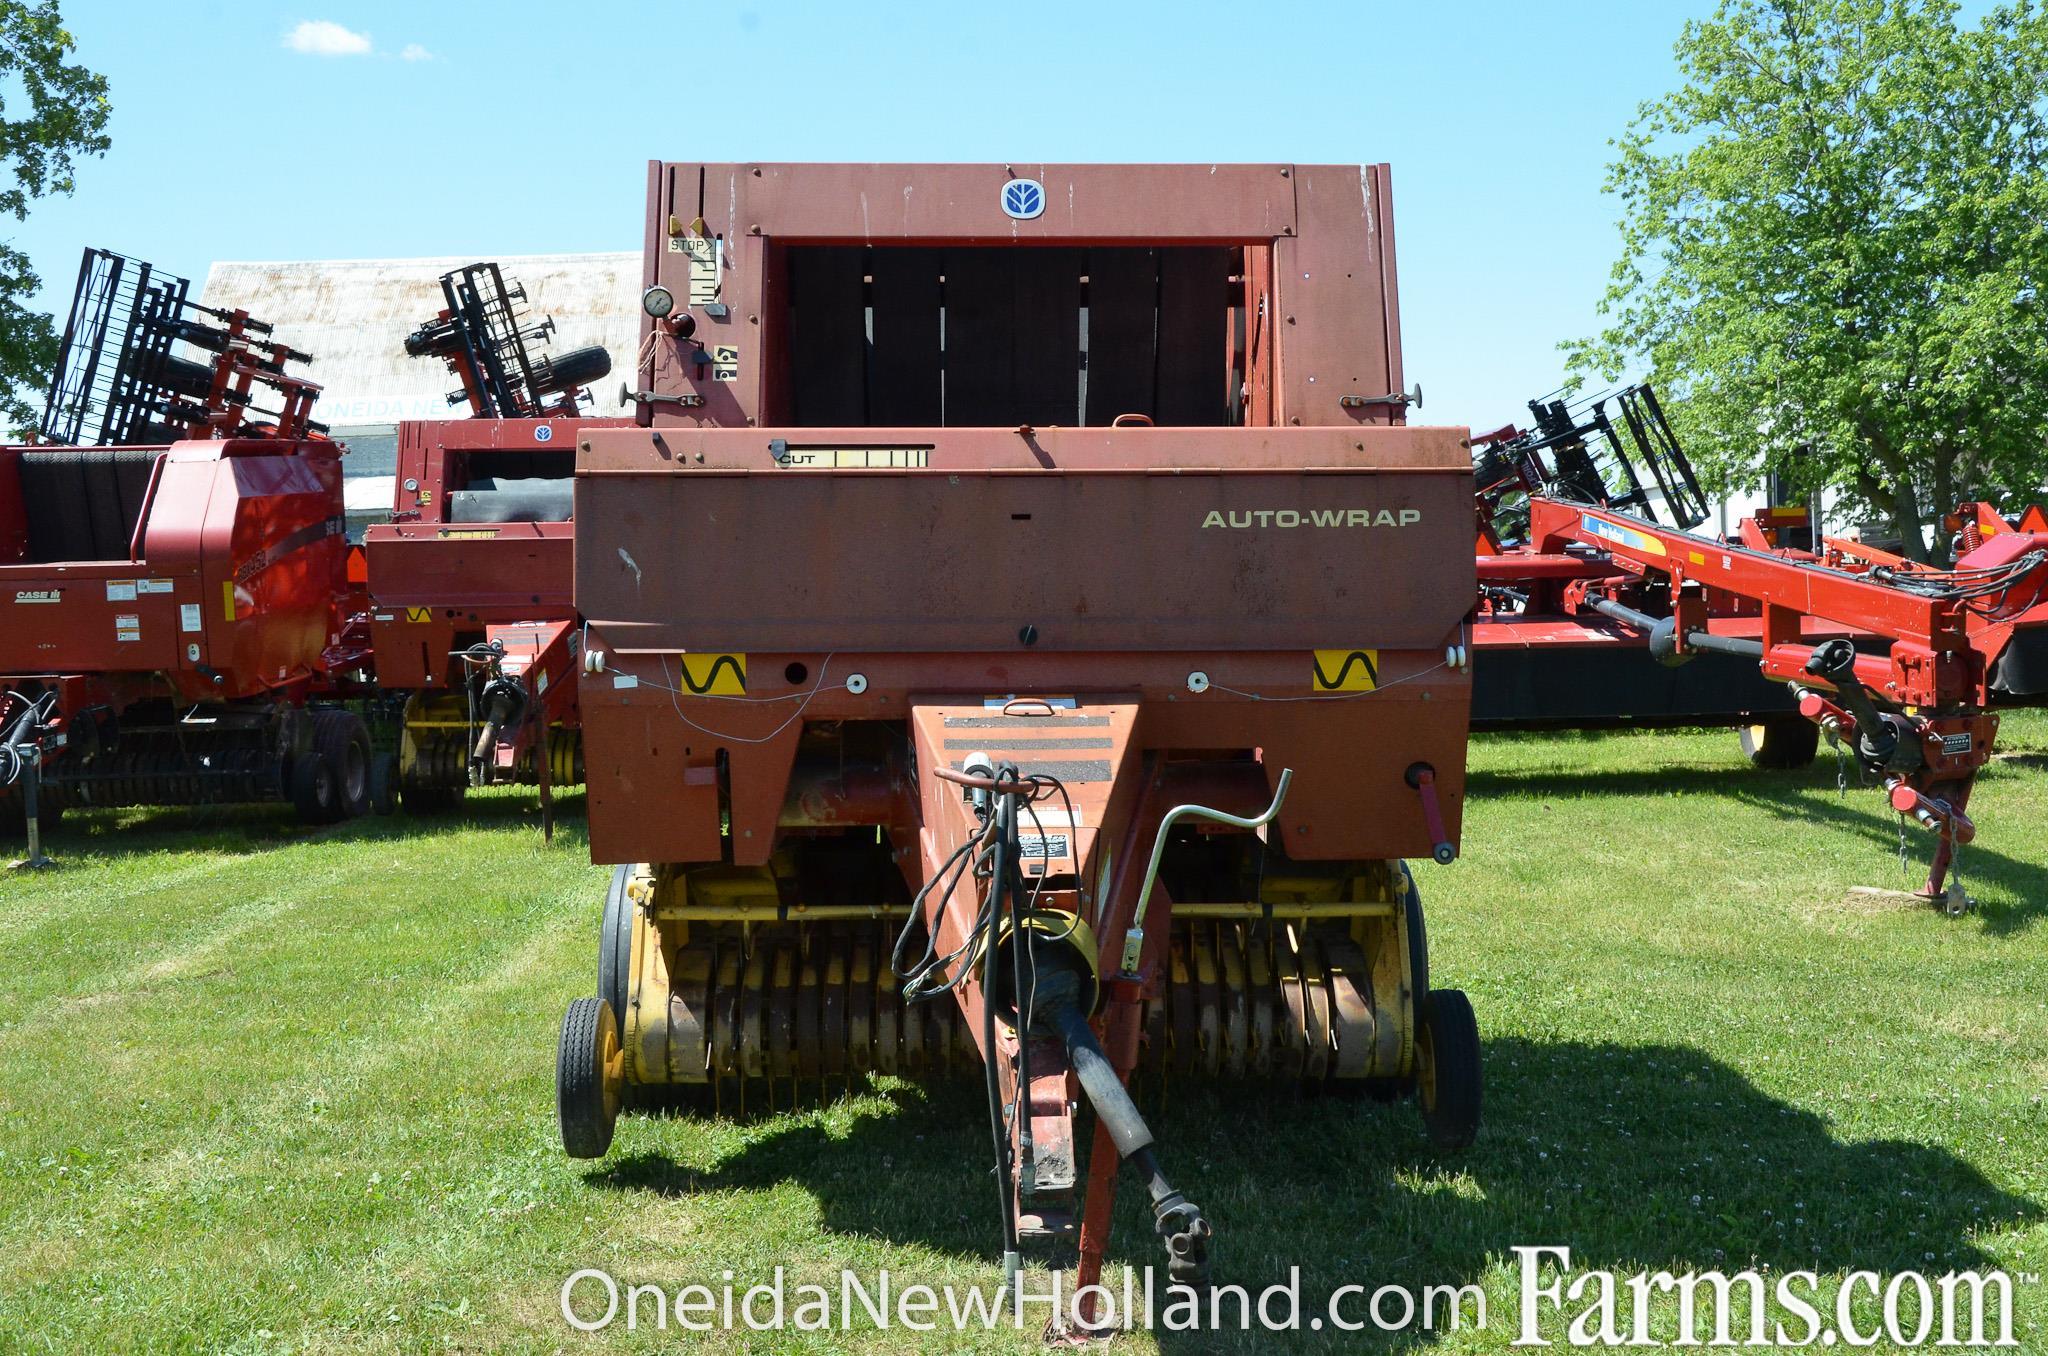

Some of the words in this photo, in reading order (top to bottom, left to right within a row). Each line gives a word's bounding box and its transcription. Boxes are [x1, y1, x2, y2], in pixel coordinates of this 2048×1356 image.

[671, 239, 704, 251] STOP
[316, 399, 403, 418] ONEIDA
[779, 455, 815, 464] CUT
[1201, 509, 1421, 528] AUTO-WRAP
[16, 591, 49, 599] CASE
